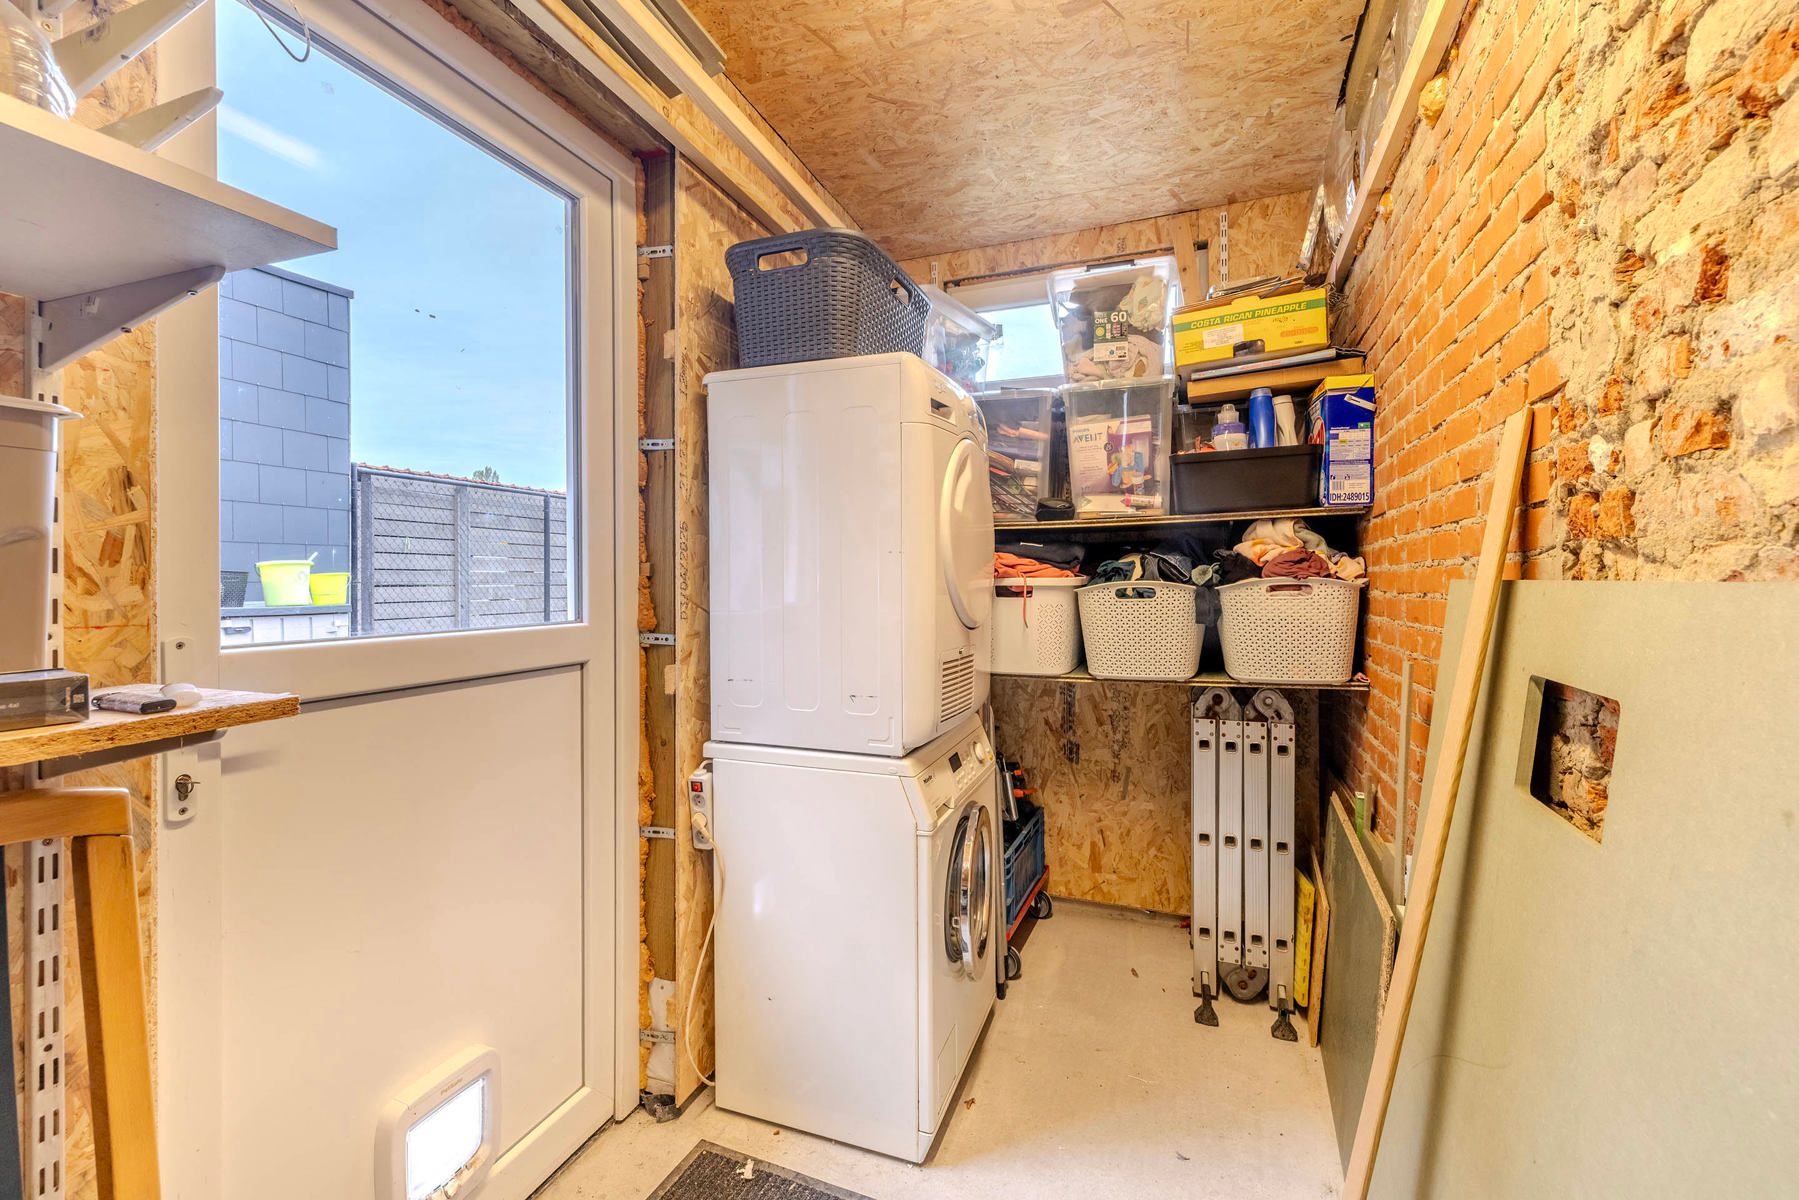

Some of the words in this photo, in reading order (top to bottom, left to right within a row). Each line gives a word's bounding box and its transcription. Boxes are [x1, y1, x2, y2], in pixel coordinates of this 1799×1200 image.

[1110, 311, 1127, 322] 60
[1190, 318, 1221, 330] COSTA
[1223, 312, 1253, 325] RICAN
[1255, 302, 1307, 318] PINEAPPLE
[1329, 491, 1370, 502] IDH:2489015
